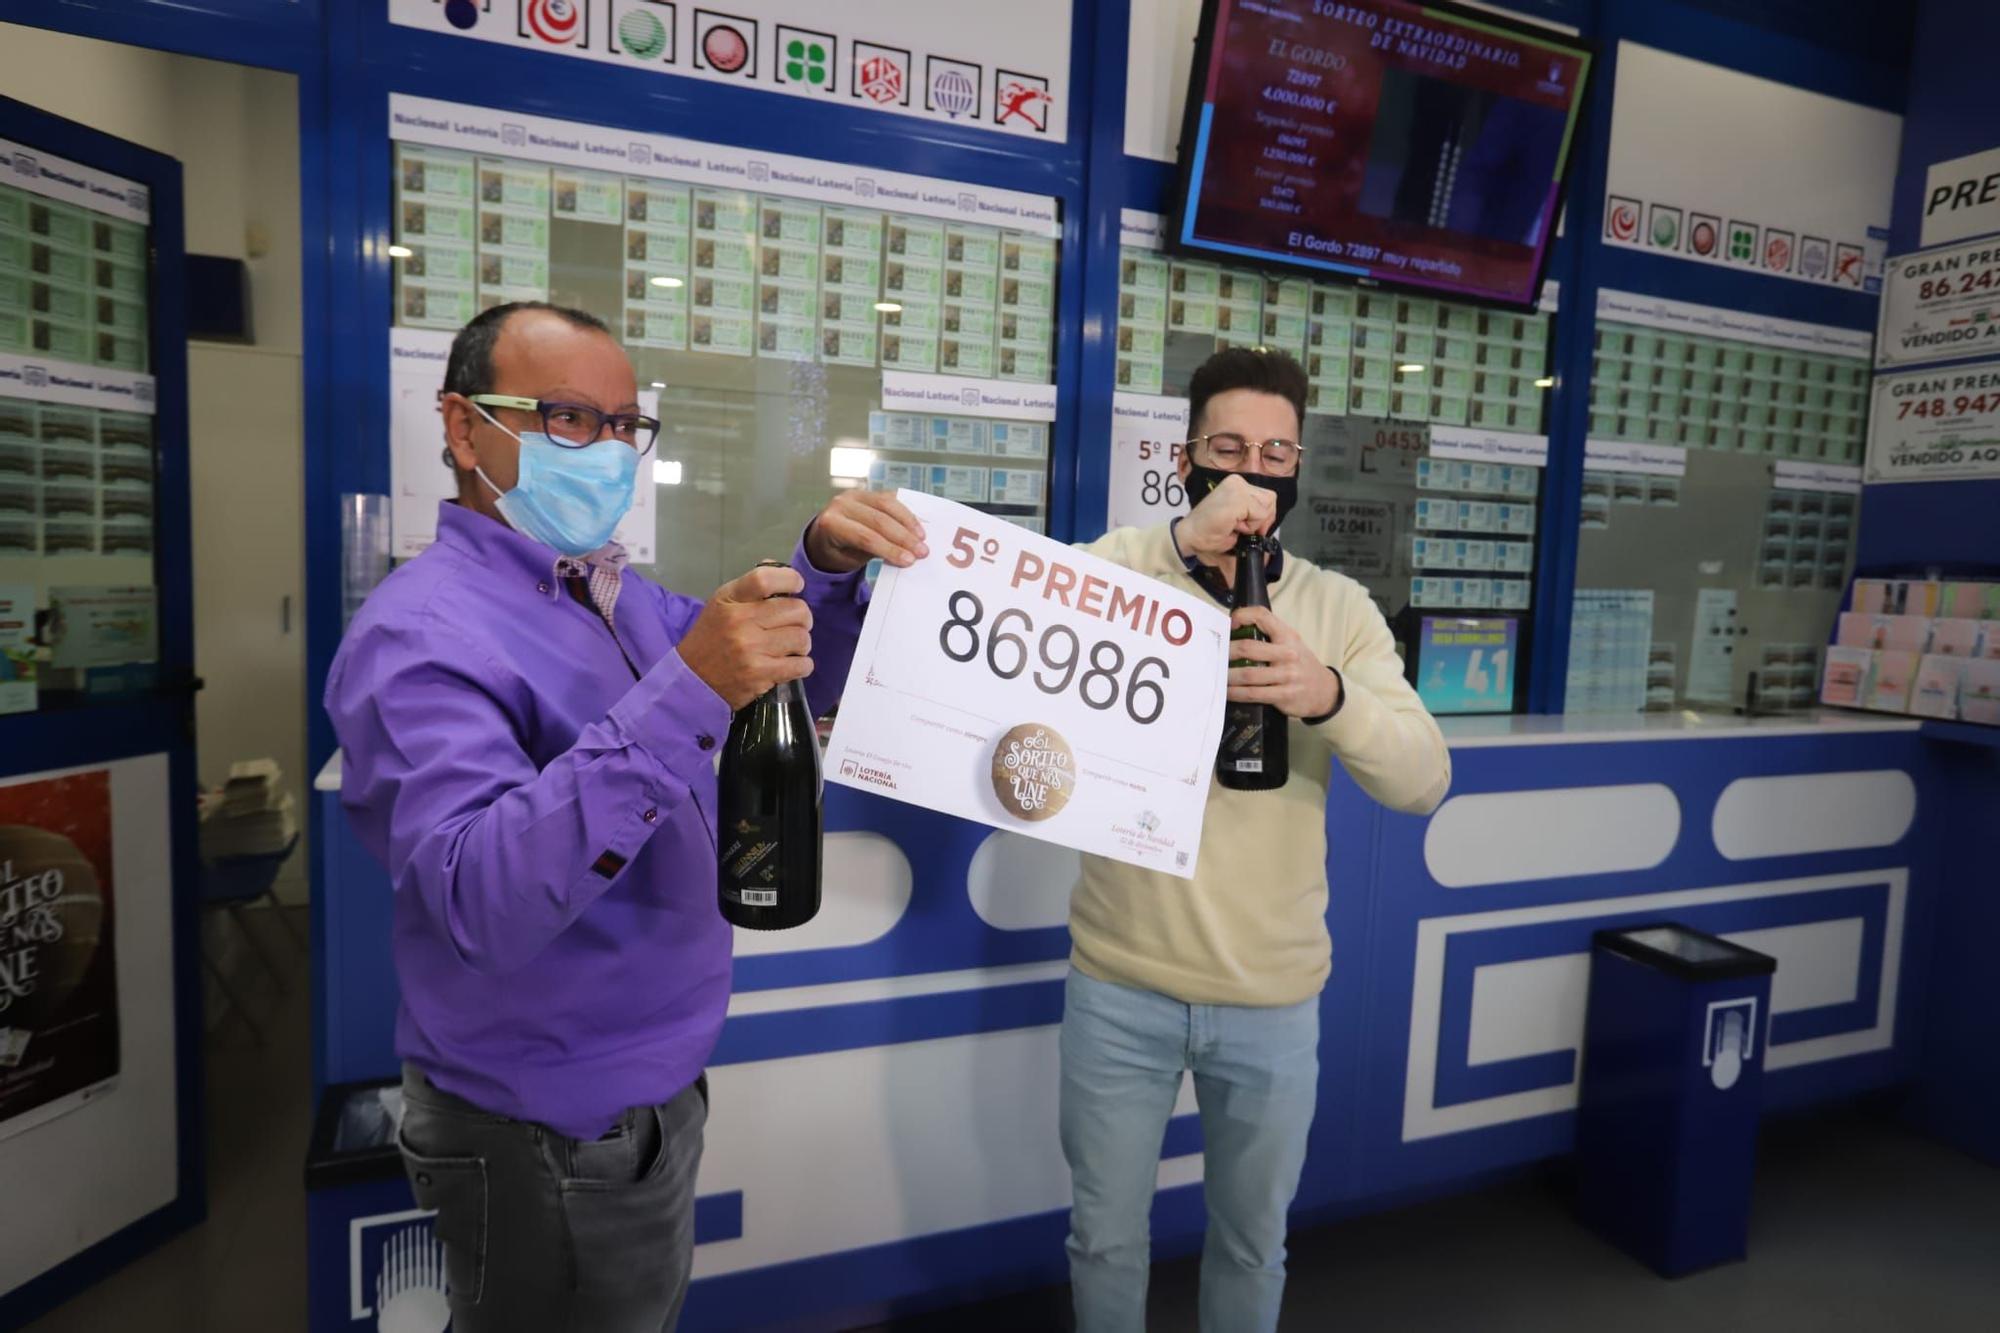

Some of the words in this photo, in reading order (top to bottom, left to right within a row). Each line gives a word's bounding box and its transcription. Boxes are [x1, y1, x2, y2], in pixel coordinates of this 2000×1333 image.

[1312, 0, 1378, 29] SORTEO
[1382, 18, 1520, 67] EXTRAORDINARIO
[1370, 31, 1394, 50] DE
[1397, 39, 1468, 70] NAVIDAD
[1291, 45, 1347, 71] GORDO
[394, 112, 450, 132] Nacional
[529, 132, 580, 151] Nacional
[653, 151, 702, 169] Nacional
[771, 169, 816, 186] Nacional
[876, 185, 919, 201] Nacional
[977, 200, 1018, 217] Nacional
[1926, 172, 2000, 217] PRE
[1288, 231, 1302, 247] El
[1304, 235, 1343, 255] Gordo
[1345, 242, 1381, 261] 72897
[1382, 252, 1408, 269] muy
[1410, 256, 1462, 279] repartido
[1904, 255, 1960, 279] GRAN
[1901, 326, 1979, 349] VENDIDO
[884, 386, 925, 400] Nacional
[981, 394, 1021, 407] Nacional
[1891, 377, 1947, 398] GRAN
[1890, 450, 1964, 468] VENDIDO
[945, 526, 1000, 570] 5º
[1010, 549, 1193, 647] PREMIO
[939, 589, 1170, 725] 86986
[1004, 741, 1068, 770] SORTEO
[857, 773, 897, 790] NACIONAL
[1009, 774, 1049, 811] UNE
[0, 867, 65, 924] TEO
